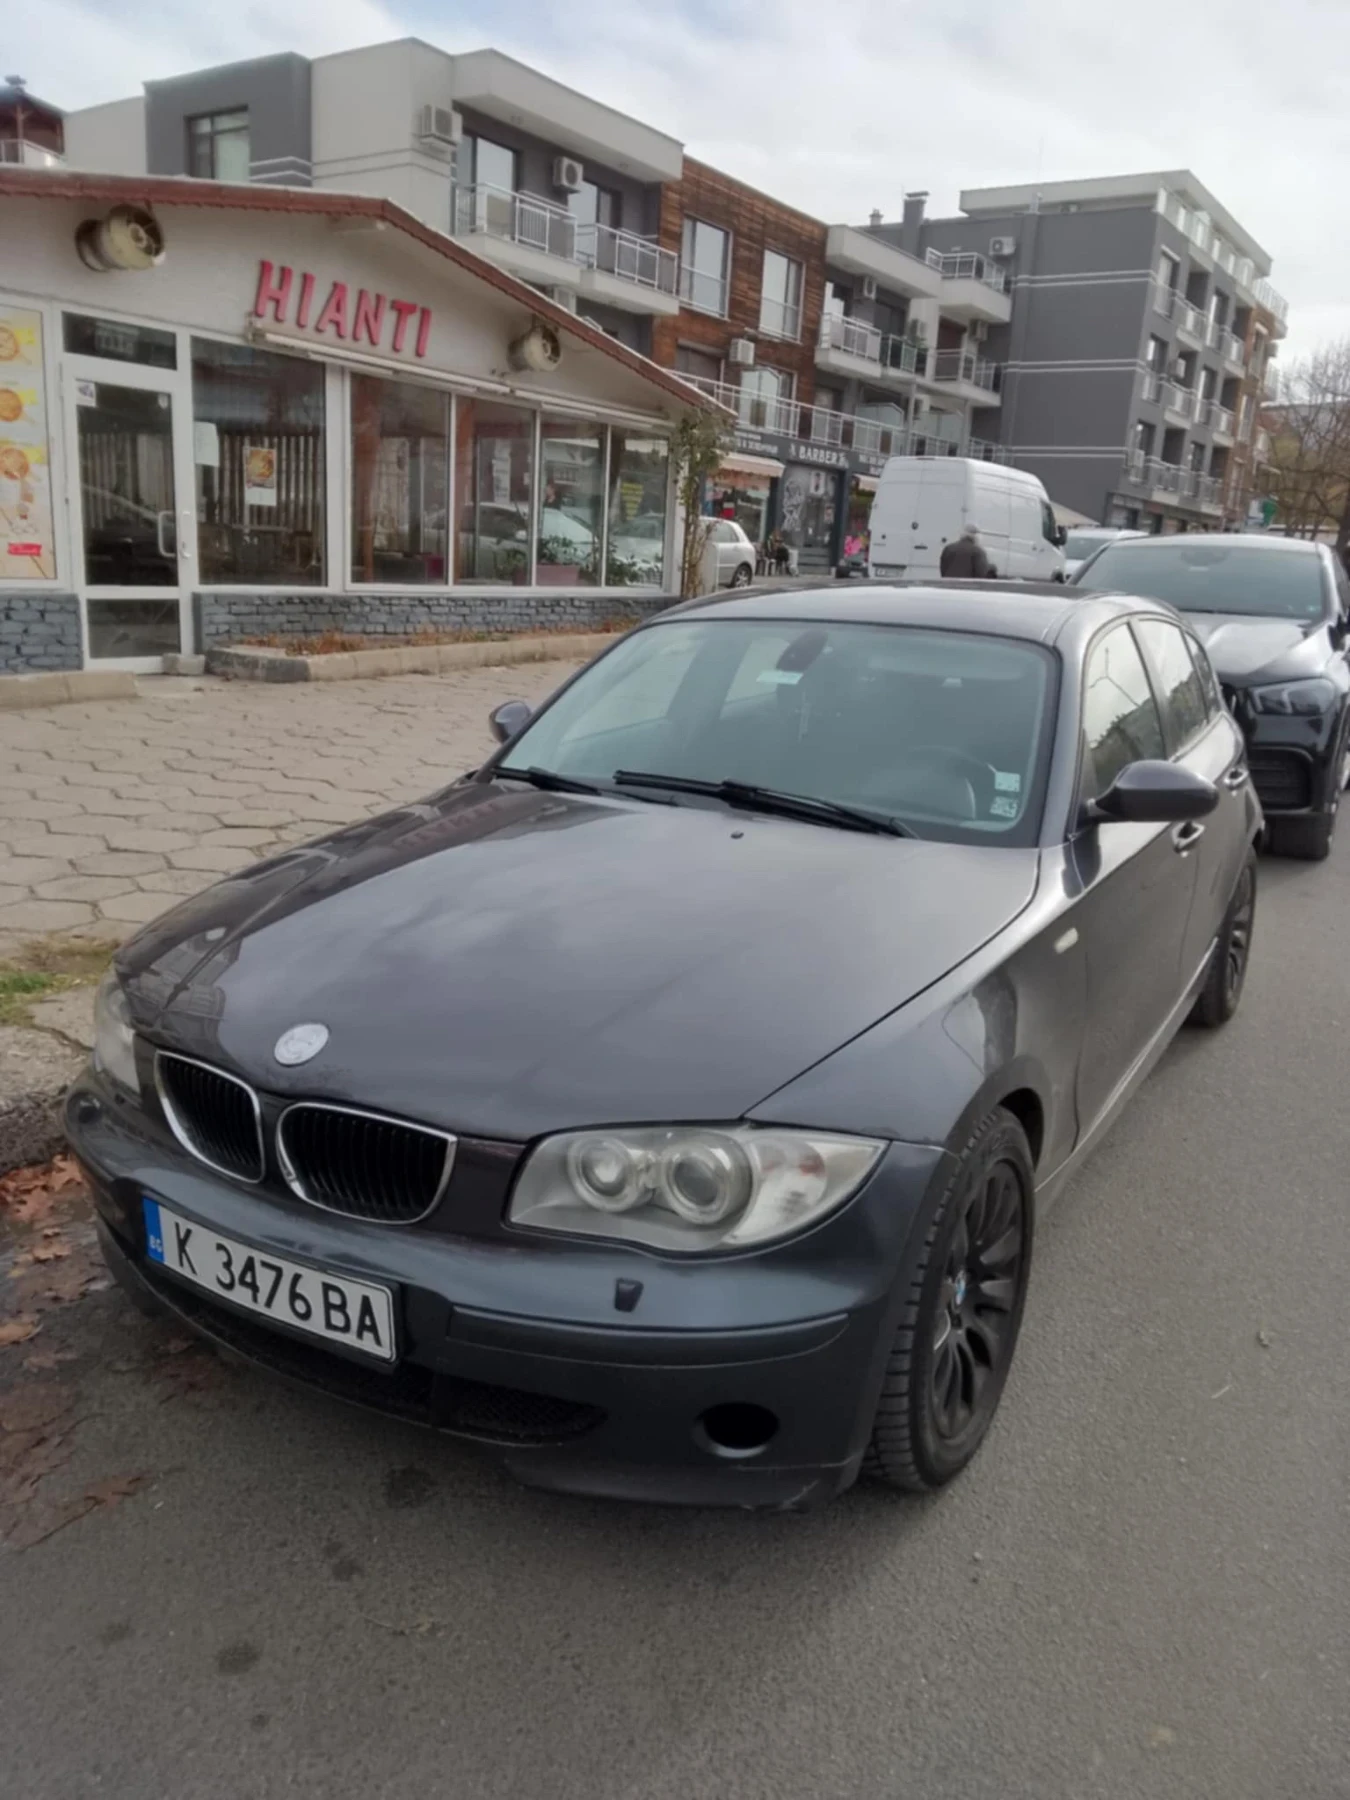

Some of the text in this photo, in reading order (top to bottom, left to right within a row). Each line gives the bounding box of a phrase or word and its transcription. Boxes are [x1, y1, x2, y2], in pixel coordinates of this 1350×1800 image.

[254, 260, 432, 357] HIANTI
[149, 1235, 162, 1252] BG
[174, 1221, 197, 1276] K
